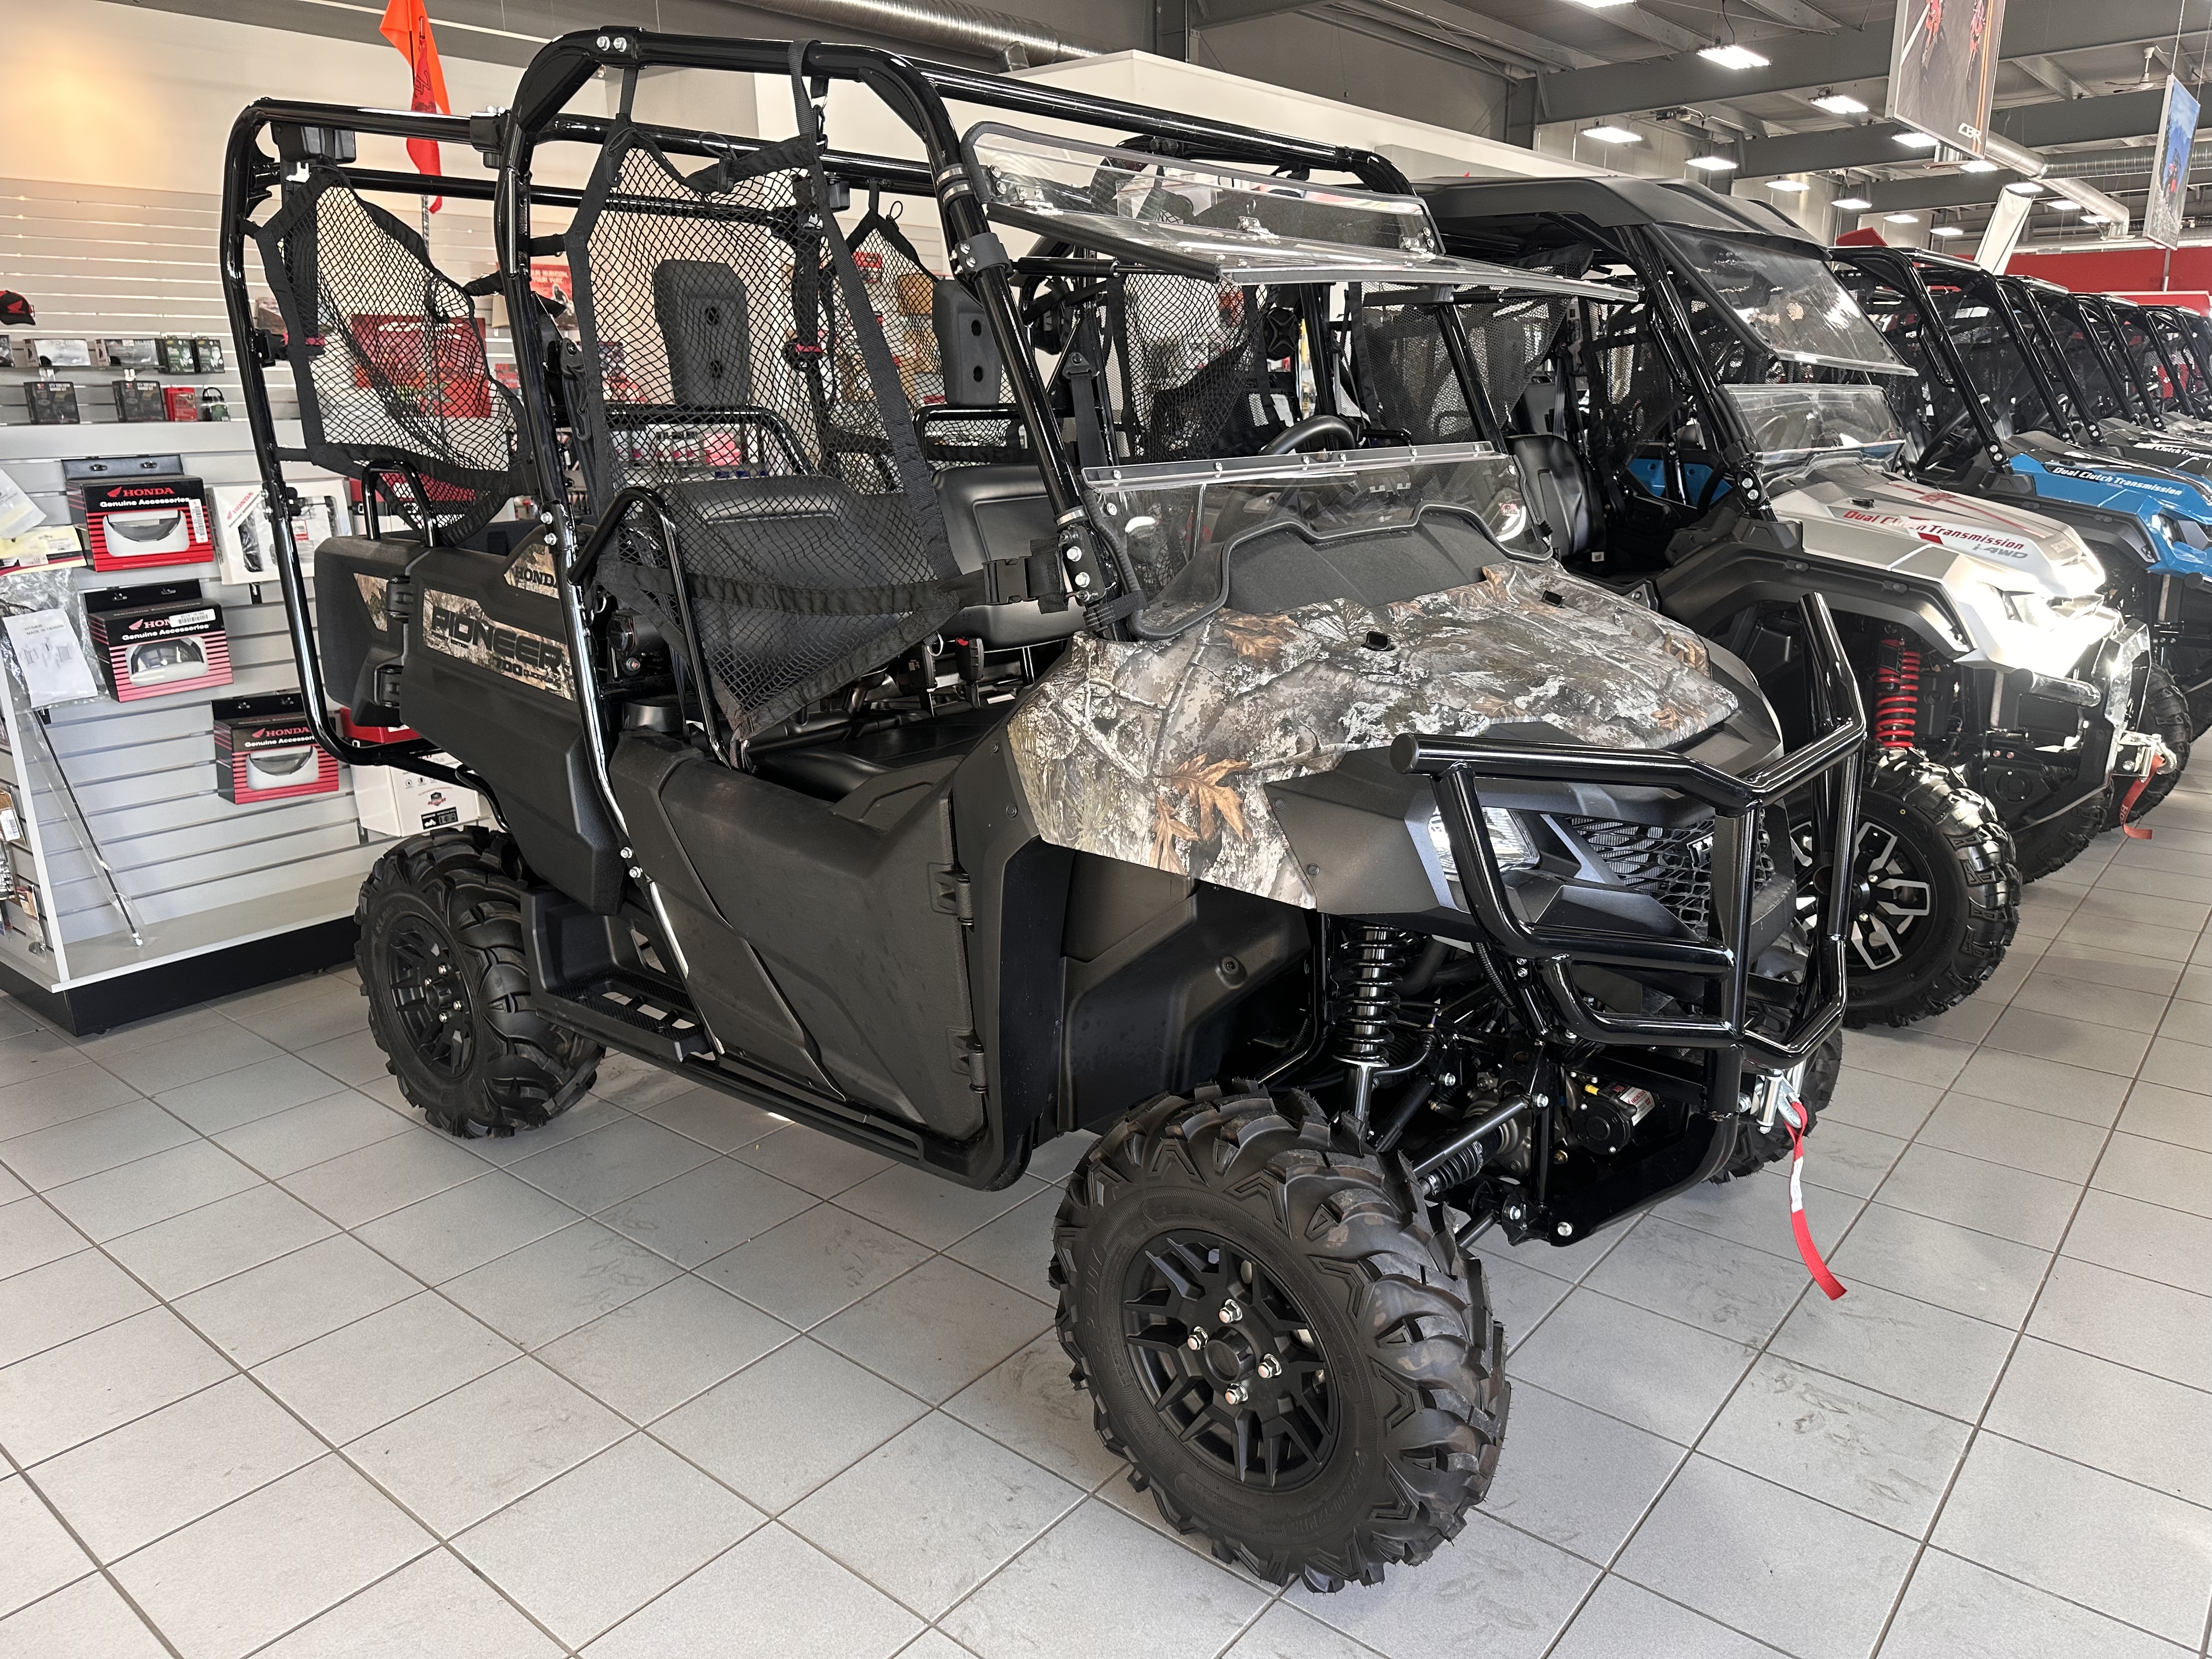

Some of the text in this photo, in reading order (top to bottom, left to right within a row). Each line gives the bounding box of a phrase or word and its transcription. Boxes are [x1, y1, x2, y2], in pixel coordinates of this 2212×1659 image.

[1958, 122, 1982, 145] CBR
[2053, 467, 2183, 496] Dual Clutch Transmission
[123, 487, 176, 497] HONDA
[139, 497, 190, 505] Accessories
[233, 492, 254, 515] HONDA
[1842, 510, 1878, 523] Dual
[1928, 524, 2024, 550] Transmission
[1972, 543, 2028, 559] i-4WD
[515, 566, 557, 588] HOND
[122, 624, 209, 641] Genuine Accessories
[144, 619, 171, 629] HON
[432, 606, 564, 673] PIONEER
[493, 657, 523, 676] 700
[266, 726, 311, 737] HONDA
[245, 735, 315, 748] Genuine Accessori
